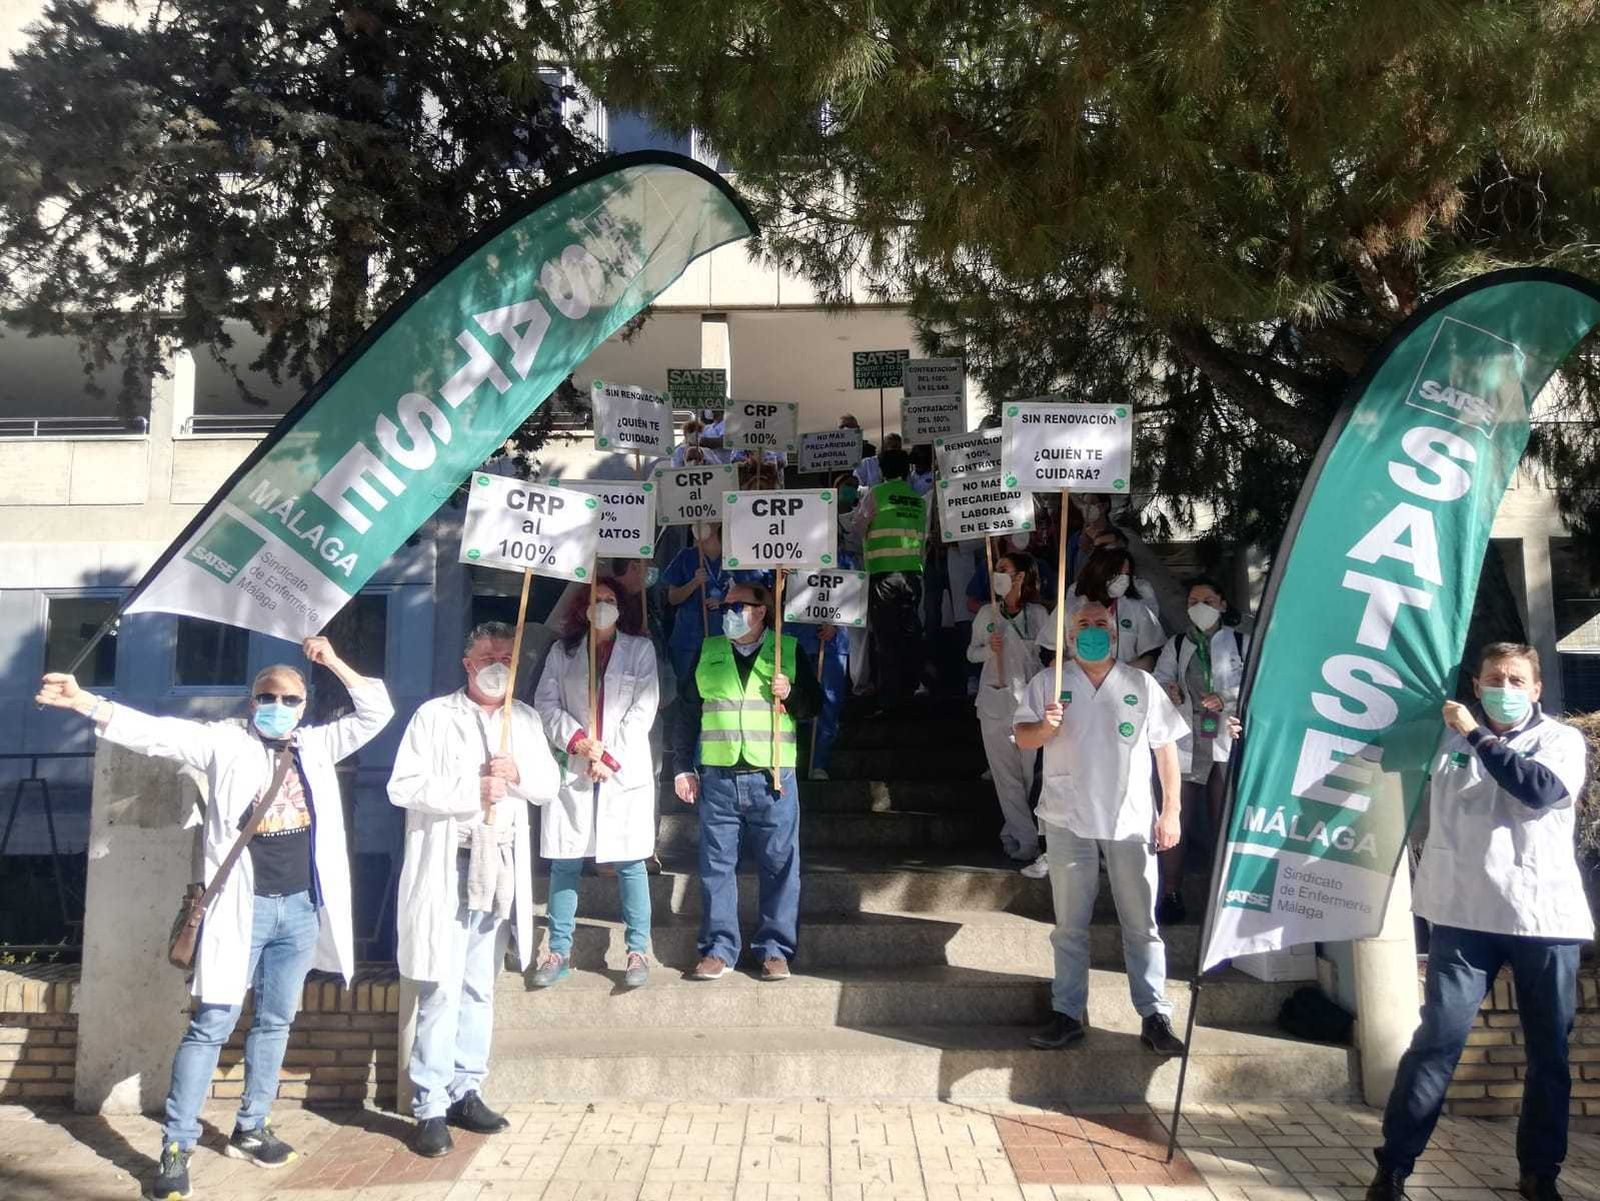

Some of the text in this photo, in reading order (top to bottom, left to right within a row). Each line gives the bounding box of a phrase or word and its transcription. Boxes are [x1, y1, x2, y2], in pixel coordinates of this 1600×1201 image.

[670, 370, 725, 384] SATSE
[311, 244, 604, 536] SATSE
[606, 388, 619, 397] SIN
[744, 404, 777, 417] CRP
[617, 416, 660, 431] ¿QUIÉN TE
[754, 419, 766, 429] al
[1021, 412, 1117, 425] SIN RENOVACIÓN
[743, 433, 777, 445] 100%
[965, 449, 991, 460] 100%
[1034, 446, 1103, 462] ¿QUIÉN TE
[951, 458, 1002, 473] CONTRATO
[1035, 466, 1100, 480] CUIDARÁ?
[675, 472, 714, 487] CRP
[962, 481, 978, 491] NO
[601, 492, 645, 505] ACIÓN
[689, 488, 702, 500] al
[948, 491, 1022, 507] PRECARIEDAD
[506, 489, 565, 516] CRP
[751, 498, 803, 517] CRP
[678, 504, 717, 518] 100%
[961, 506, 1010, 519] LABORAL
[250, 479, 359, 577] MÁLAGA
[521, 518, 542, 535] al
[598, 528, 640, 539] RATOS
[769, 519, 785, 535] al
[960, 519, 1014, 533] EN EL SAS
[498, 539, 556, 566] 100%
[752, 542, 803, 559] 100%
[191, 545, 238, 579] SATSE
[249, 565, 265, 580] de
[260, 551, 309, 593] Sindicato
[807, 574, 844, 588] CRP
[237, 577, 279, 611] Málaga
[818, 590, 830, 601] al
[805, 606, 841, 619] 100%
[1290, 426, 1478, 813] SATSE
[1243, 805, 1378, 858] MÁLAGA
[1282, 866, 1344, 891] Sindicato
[1280, 884, 1295, 897] de
